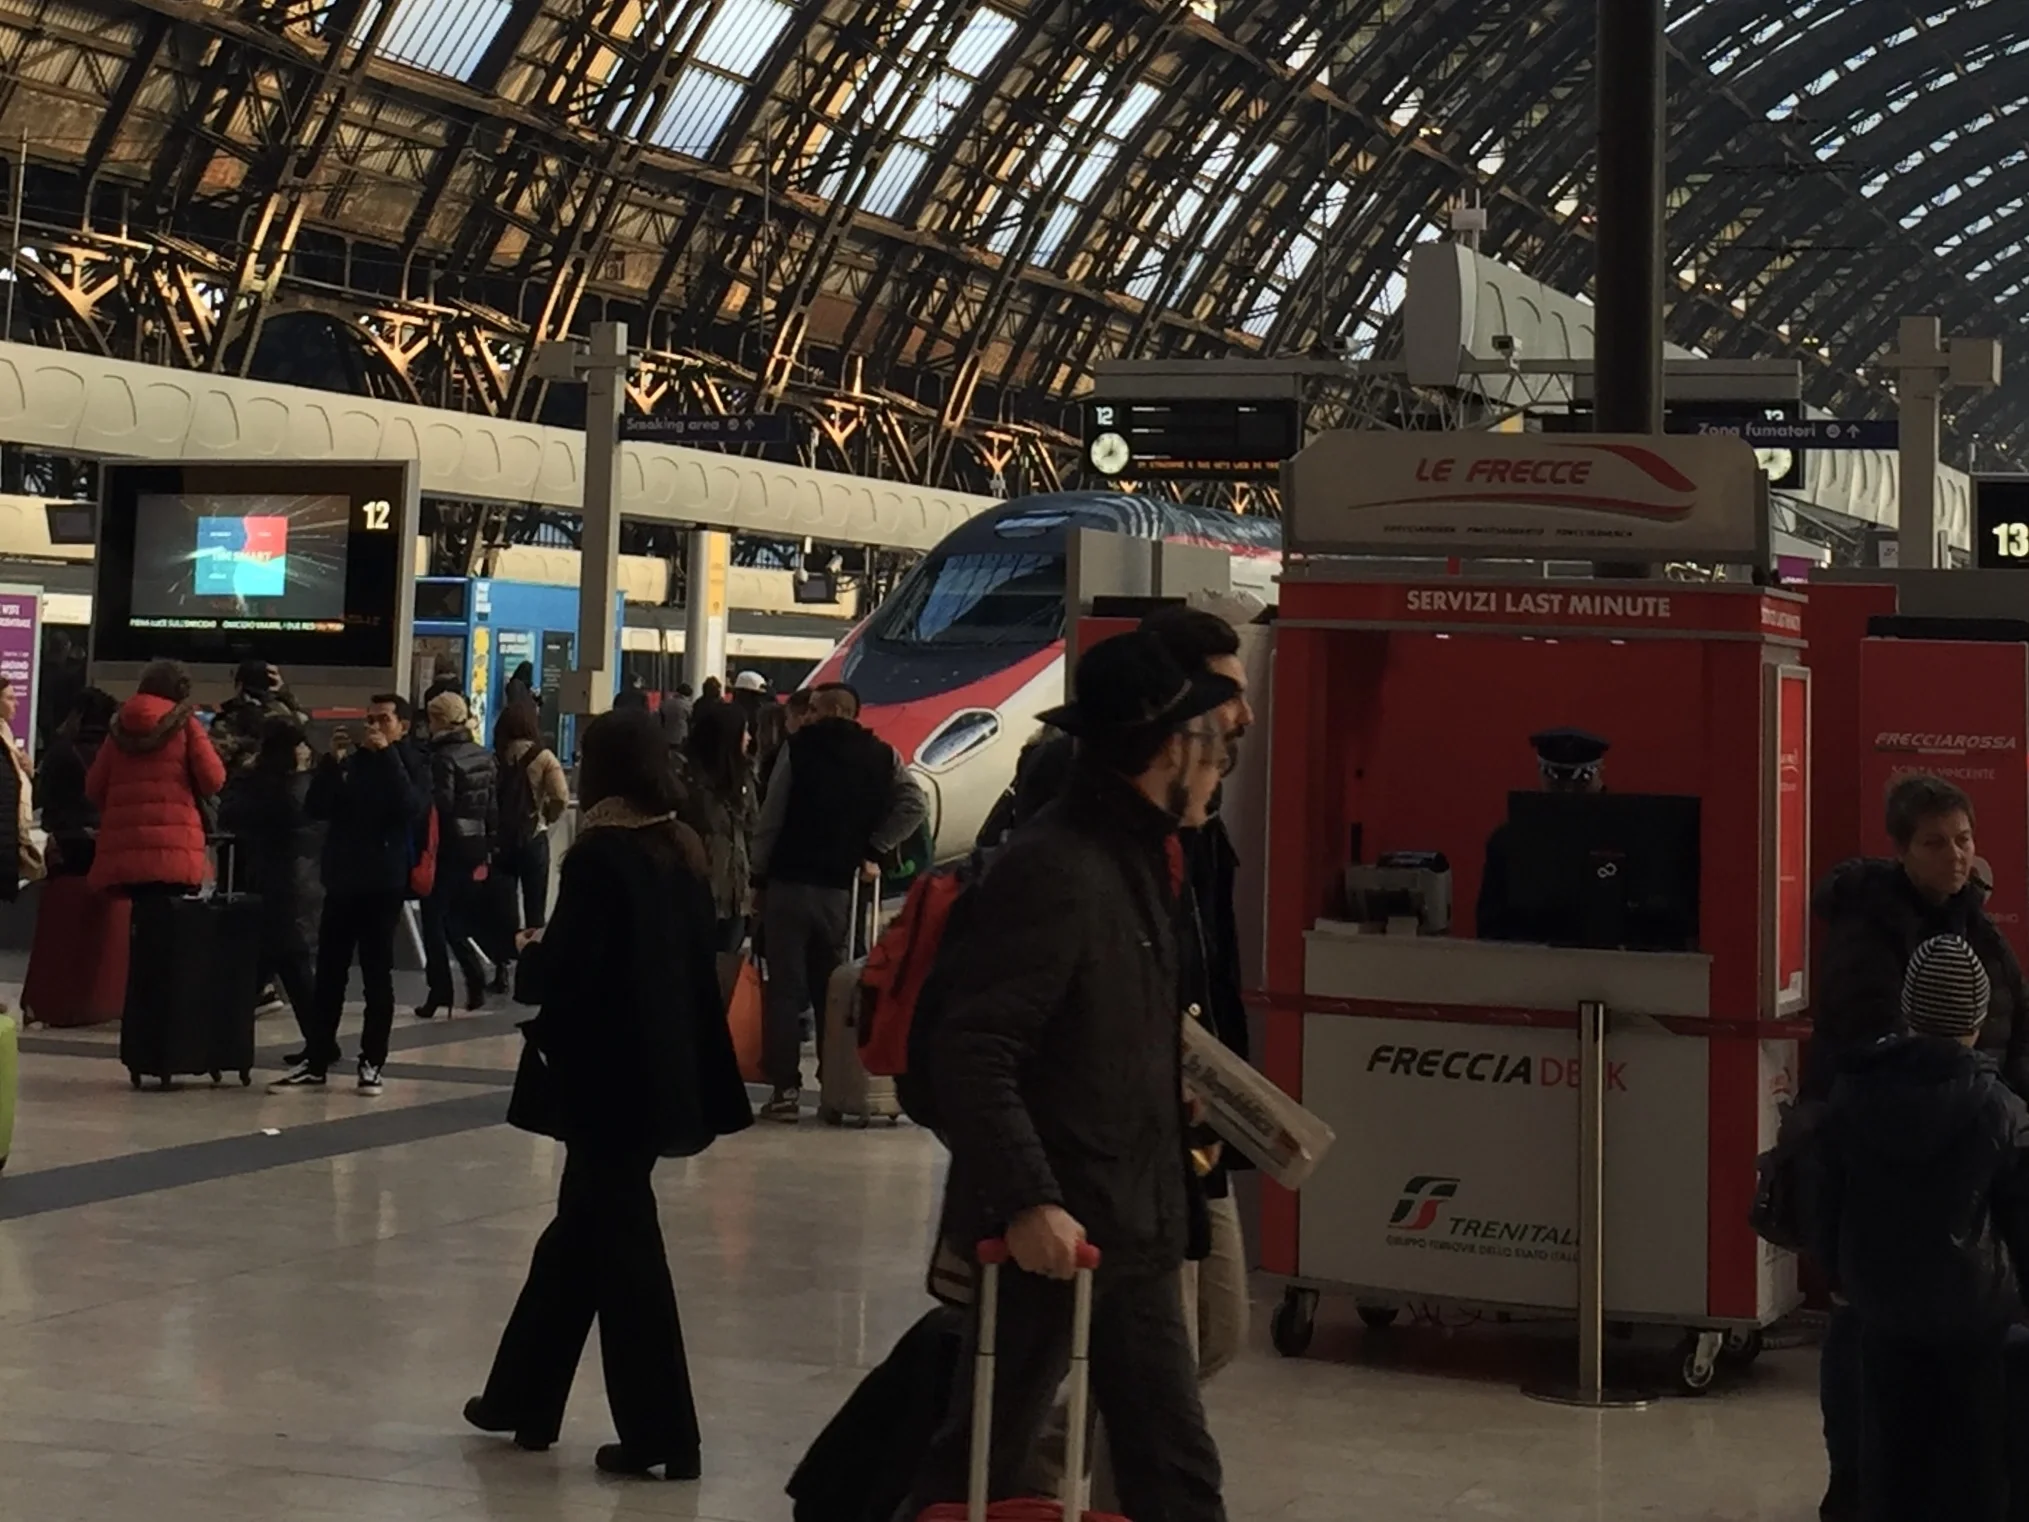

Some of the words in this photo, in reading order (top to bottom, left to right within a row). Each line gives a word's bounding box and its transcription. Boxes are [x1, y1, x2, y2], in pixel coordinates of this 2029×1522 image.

[626, 417, 685, 433] Smoking
[688, 420, 720, 431] area
[1096, 407, 1114, 425] 12
[1698, 423, 1740, 437] Zona
[1745, 422, 1816, 437] fumatori
[1416, 458, 1456, 482] LE
[1465, 459, 1593, 485] FRECCE
[363, 501, 390, 530] 12
[1992, 523, 2028, 557] 13
[1407, 590, 1496, 612] SERVIZI
[1505, 592, 1564, 614] LAST
[1568, 595, 1671, 617] MINUTE
[1874, 732, 2017, 749] FRECCIAROSSA
